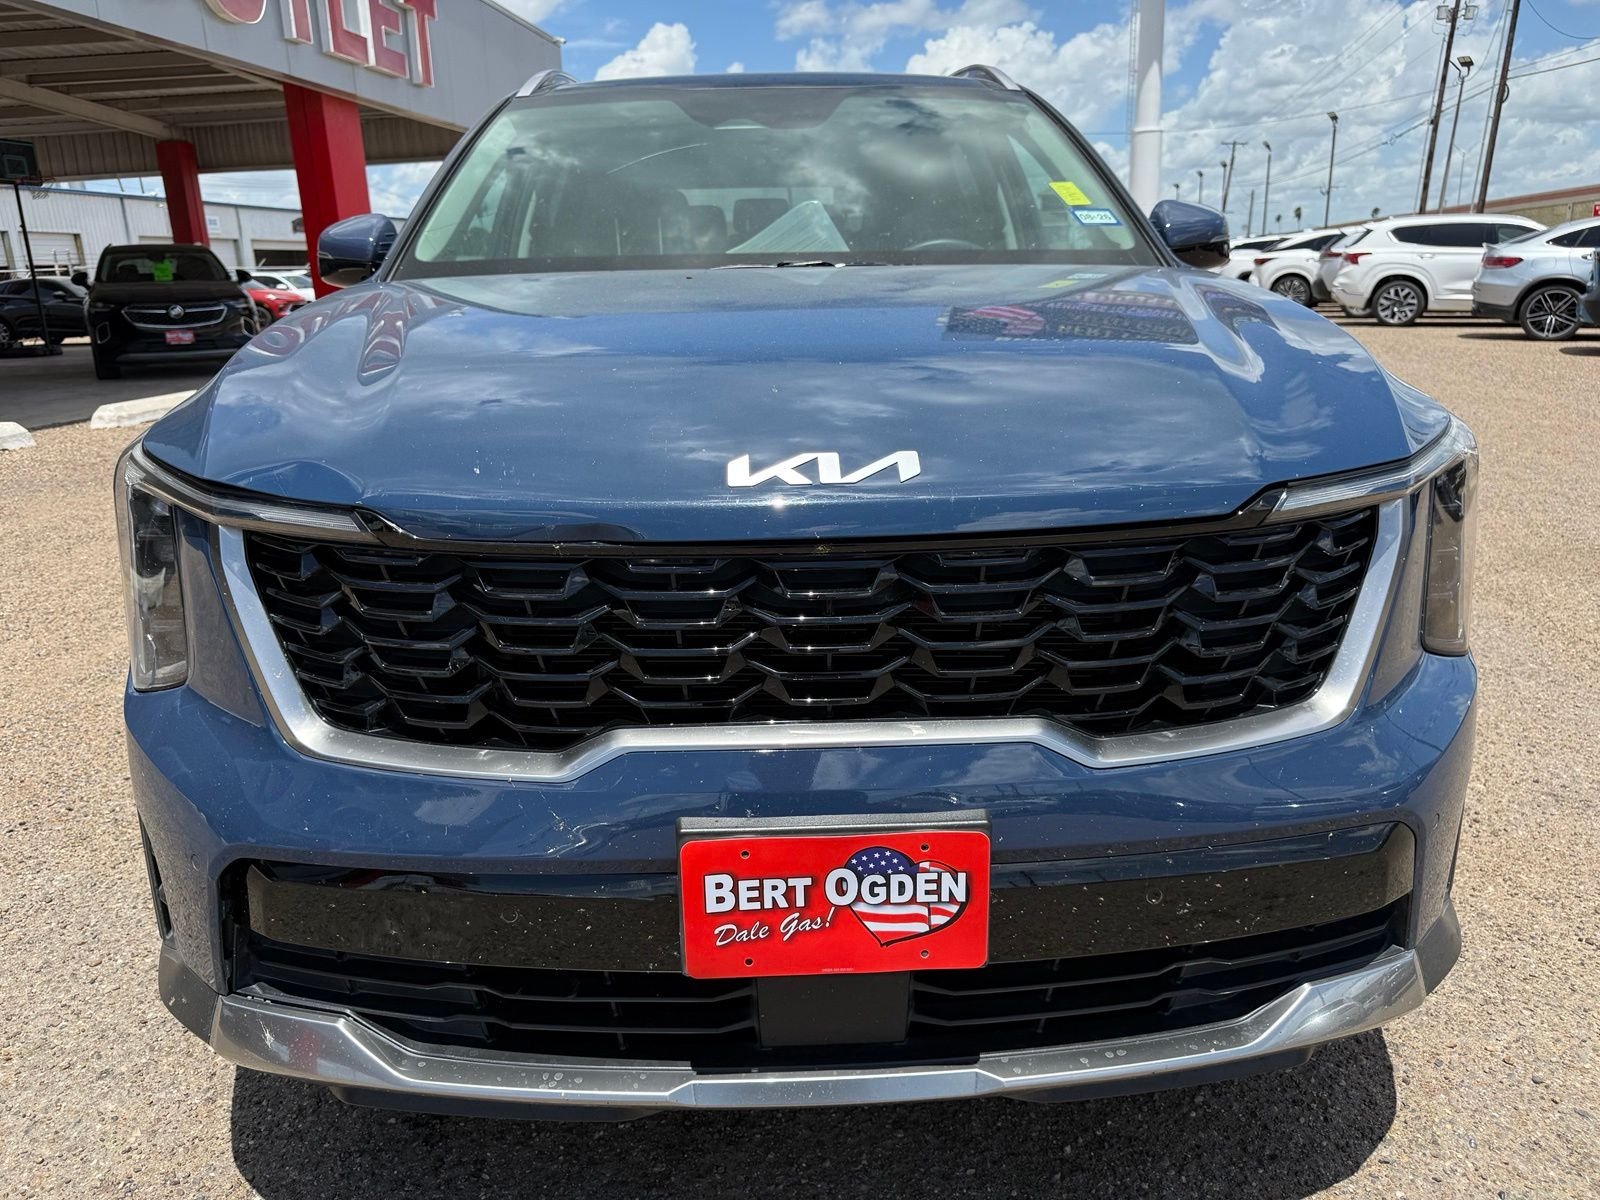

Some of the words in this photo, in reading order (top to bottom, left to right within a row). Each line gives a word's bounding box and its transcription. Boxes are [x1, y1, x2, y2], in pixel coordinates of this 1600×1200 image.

[727, 450, 921, 487] KIA
[704, 873, 813, 914] BERT
[824, 867, 968, 906] OGDEN
[713, 920, 770, 946] Dale
[779, 906, 836, 941] Gas!
